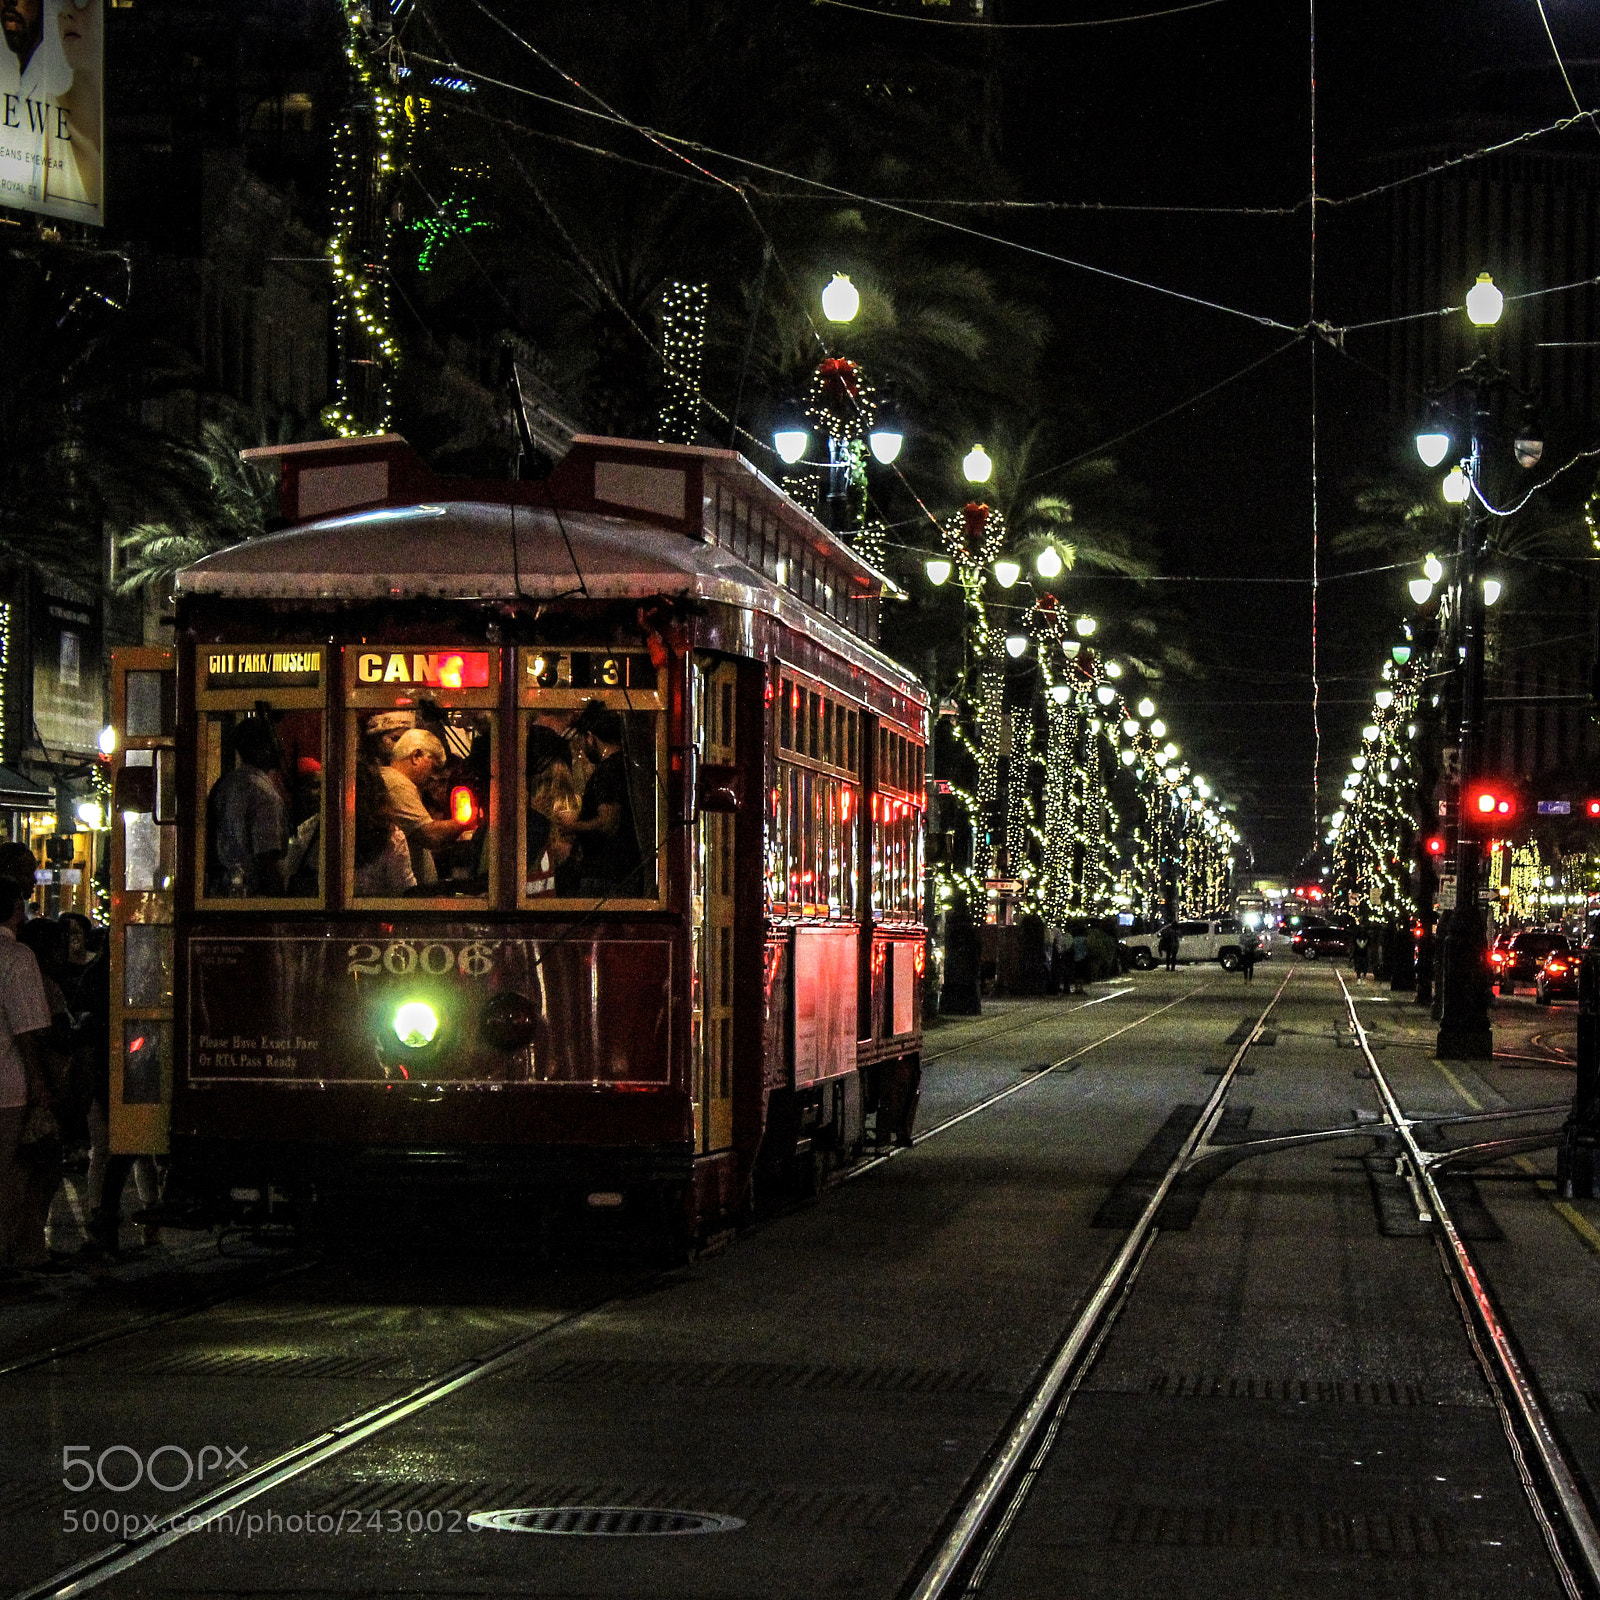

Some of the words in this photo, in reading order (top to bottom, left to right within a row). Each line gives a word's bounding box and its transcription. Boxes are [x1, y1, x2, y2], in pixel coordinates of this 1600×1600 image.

[25, 152, 64, 171] EYEWEAR
[1, 178, 26, 194] ROYAL
[28, 184, 37, 197] ST
[209, 654, 234, 673] CITY
[358, 652, 476, 683] CAN
[347, 943, 494, 975] 2006
[199, 1035, 229, 1049] Please
[232, 1035, 257, 1049] Have
[261, 1035, 291, 1050] Exact
[295, 1035, 319, 1050] Fare
[240, 1054, 262, 1067] Pass
[265, 1054, 298, 1071] Ready
